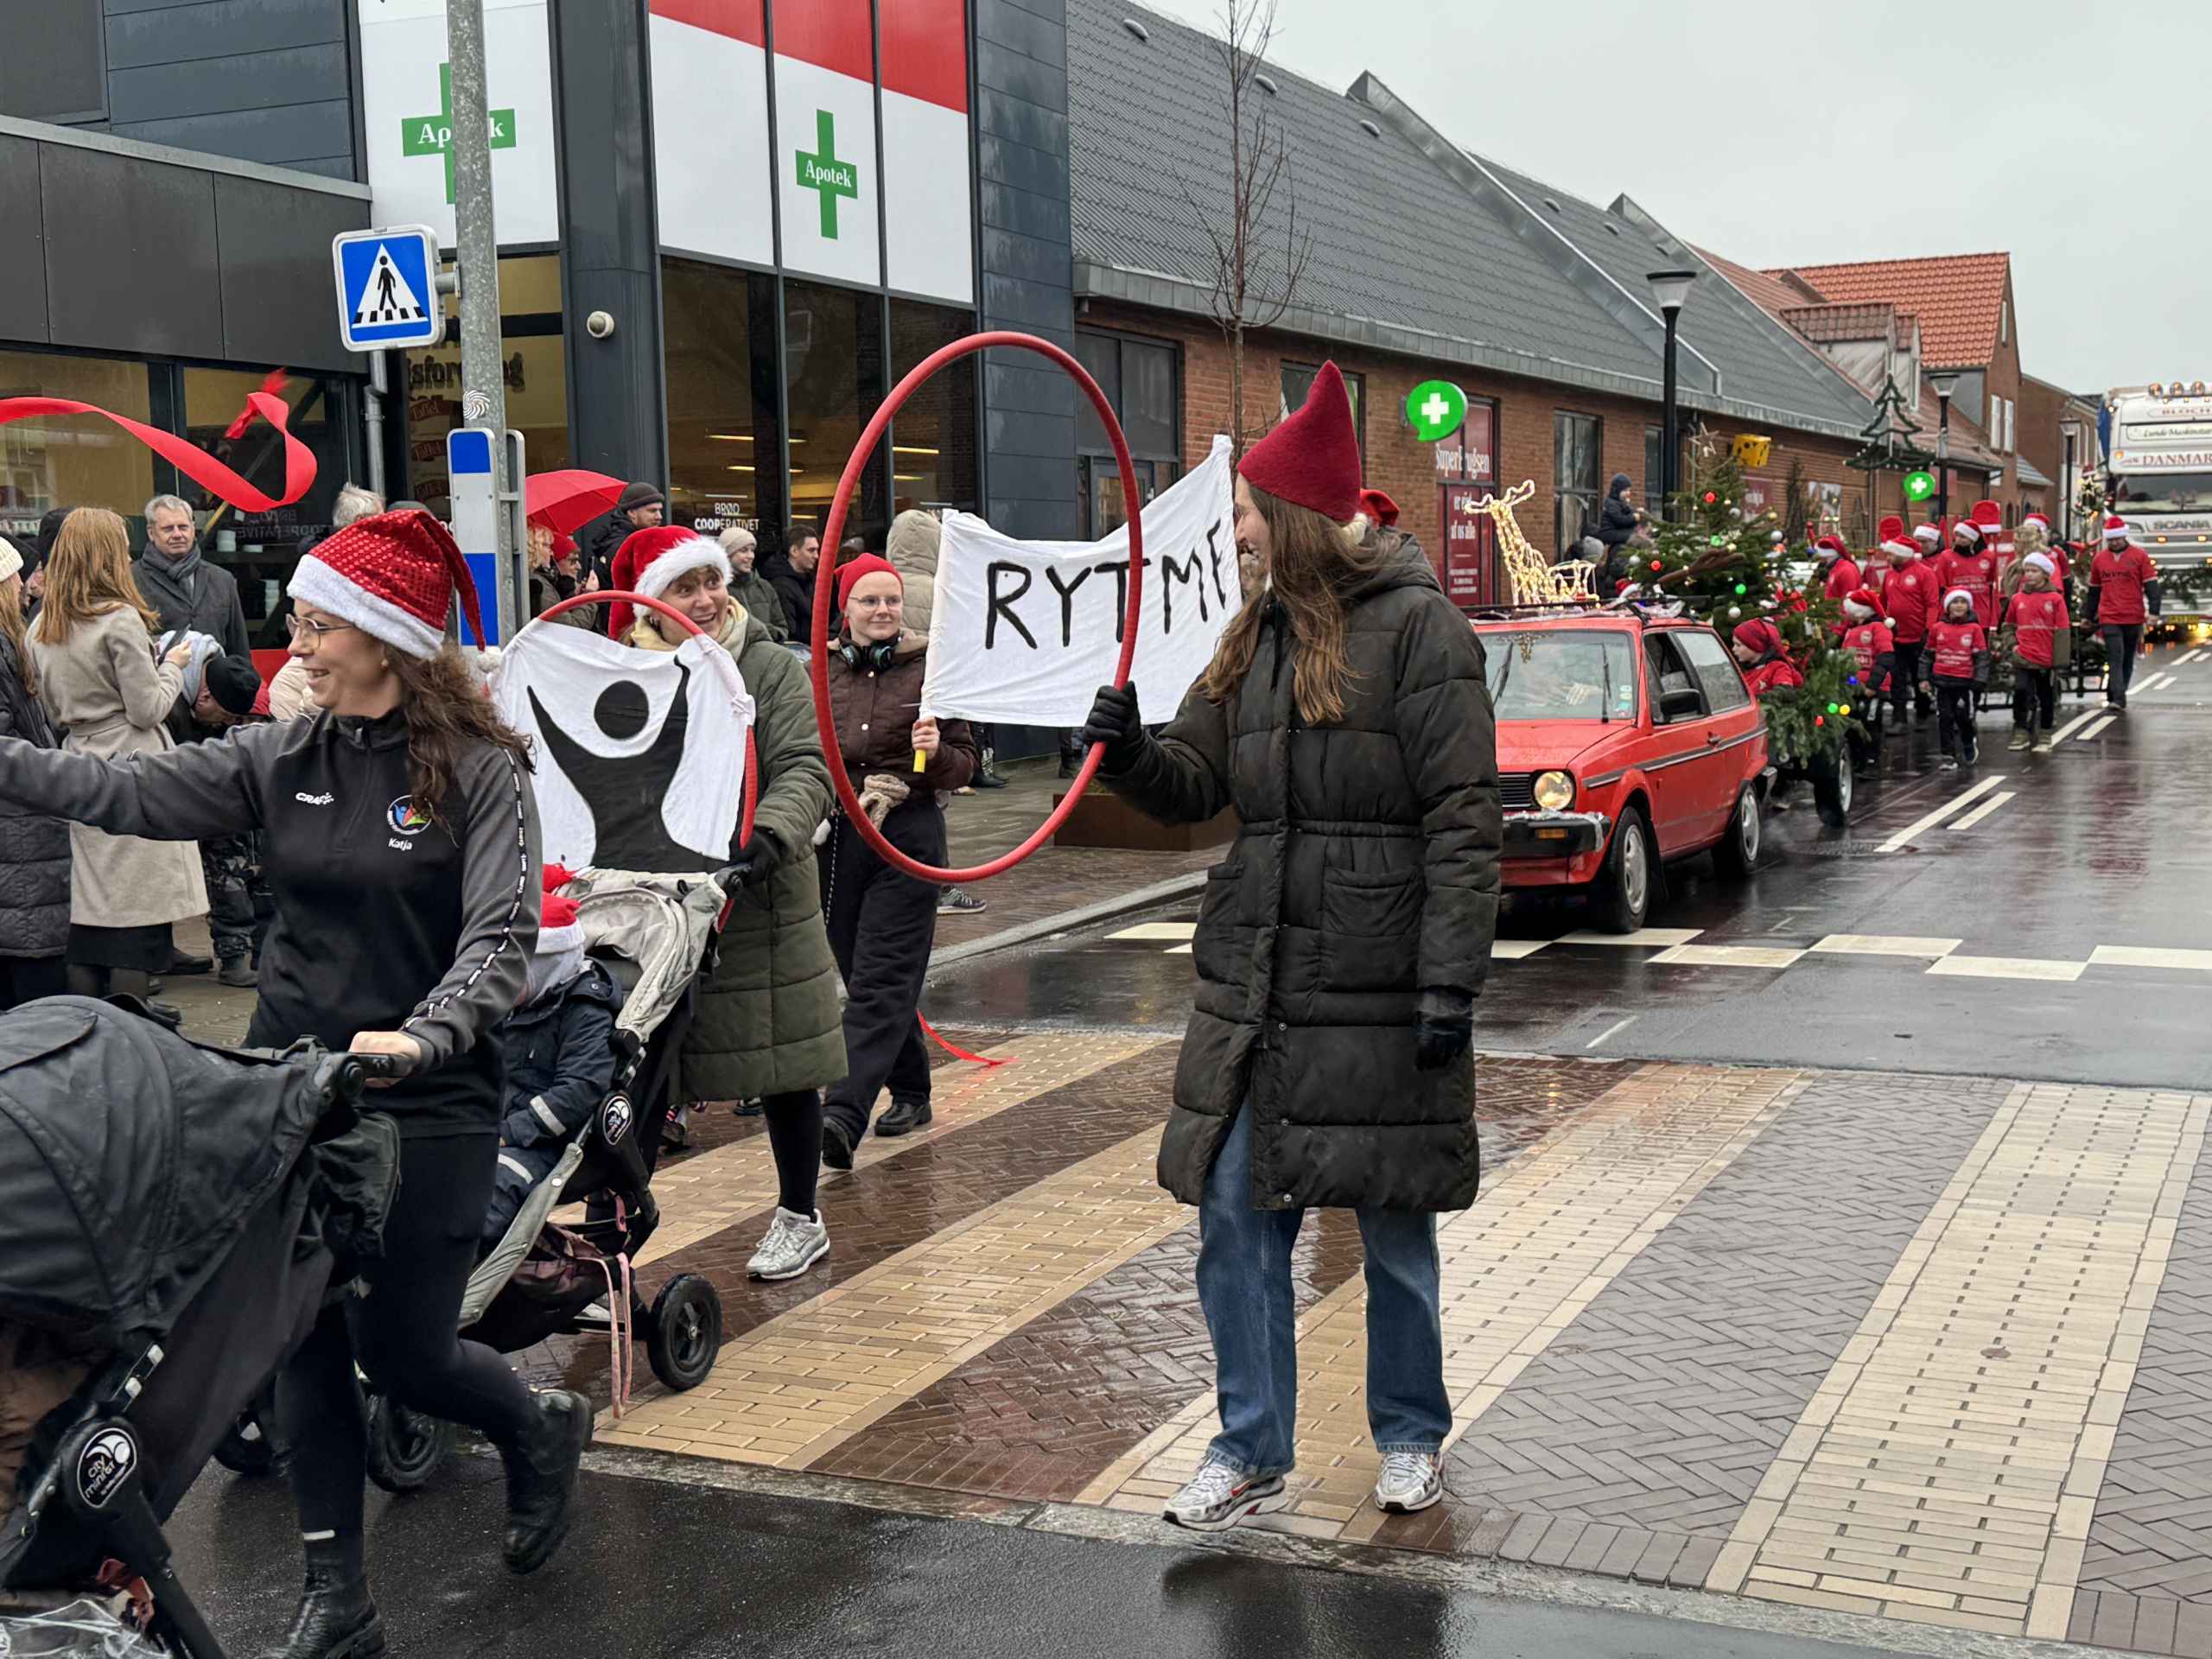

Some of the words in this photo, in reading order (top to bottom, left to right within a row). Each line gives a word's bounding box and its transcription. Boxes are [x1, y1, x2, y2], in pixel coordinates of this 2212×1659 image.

[417, 117, 505, 149] Apk
[805, 160, 852, 188] Apotek
[715, 502, 741, 516] BRØD
[694, 518, 760, 531] COOPERATIVET
[388, 837, 413, 851] Katja
